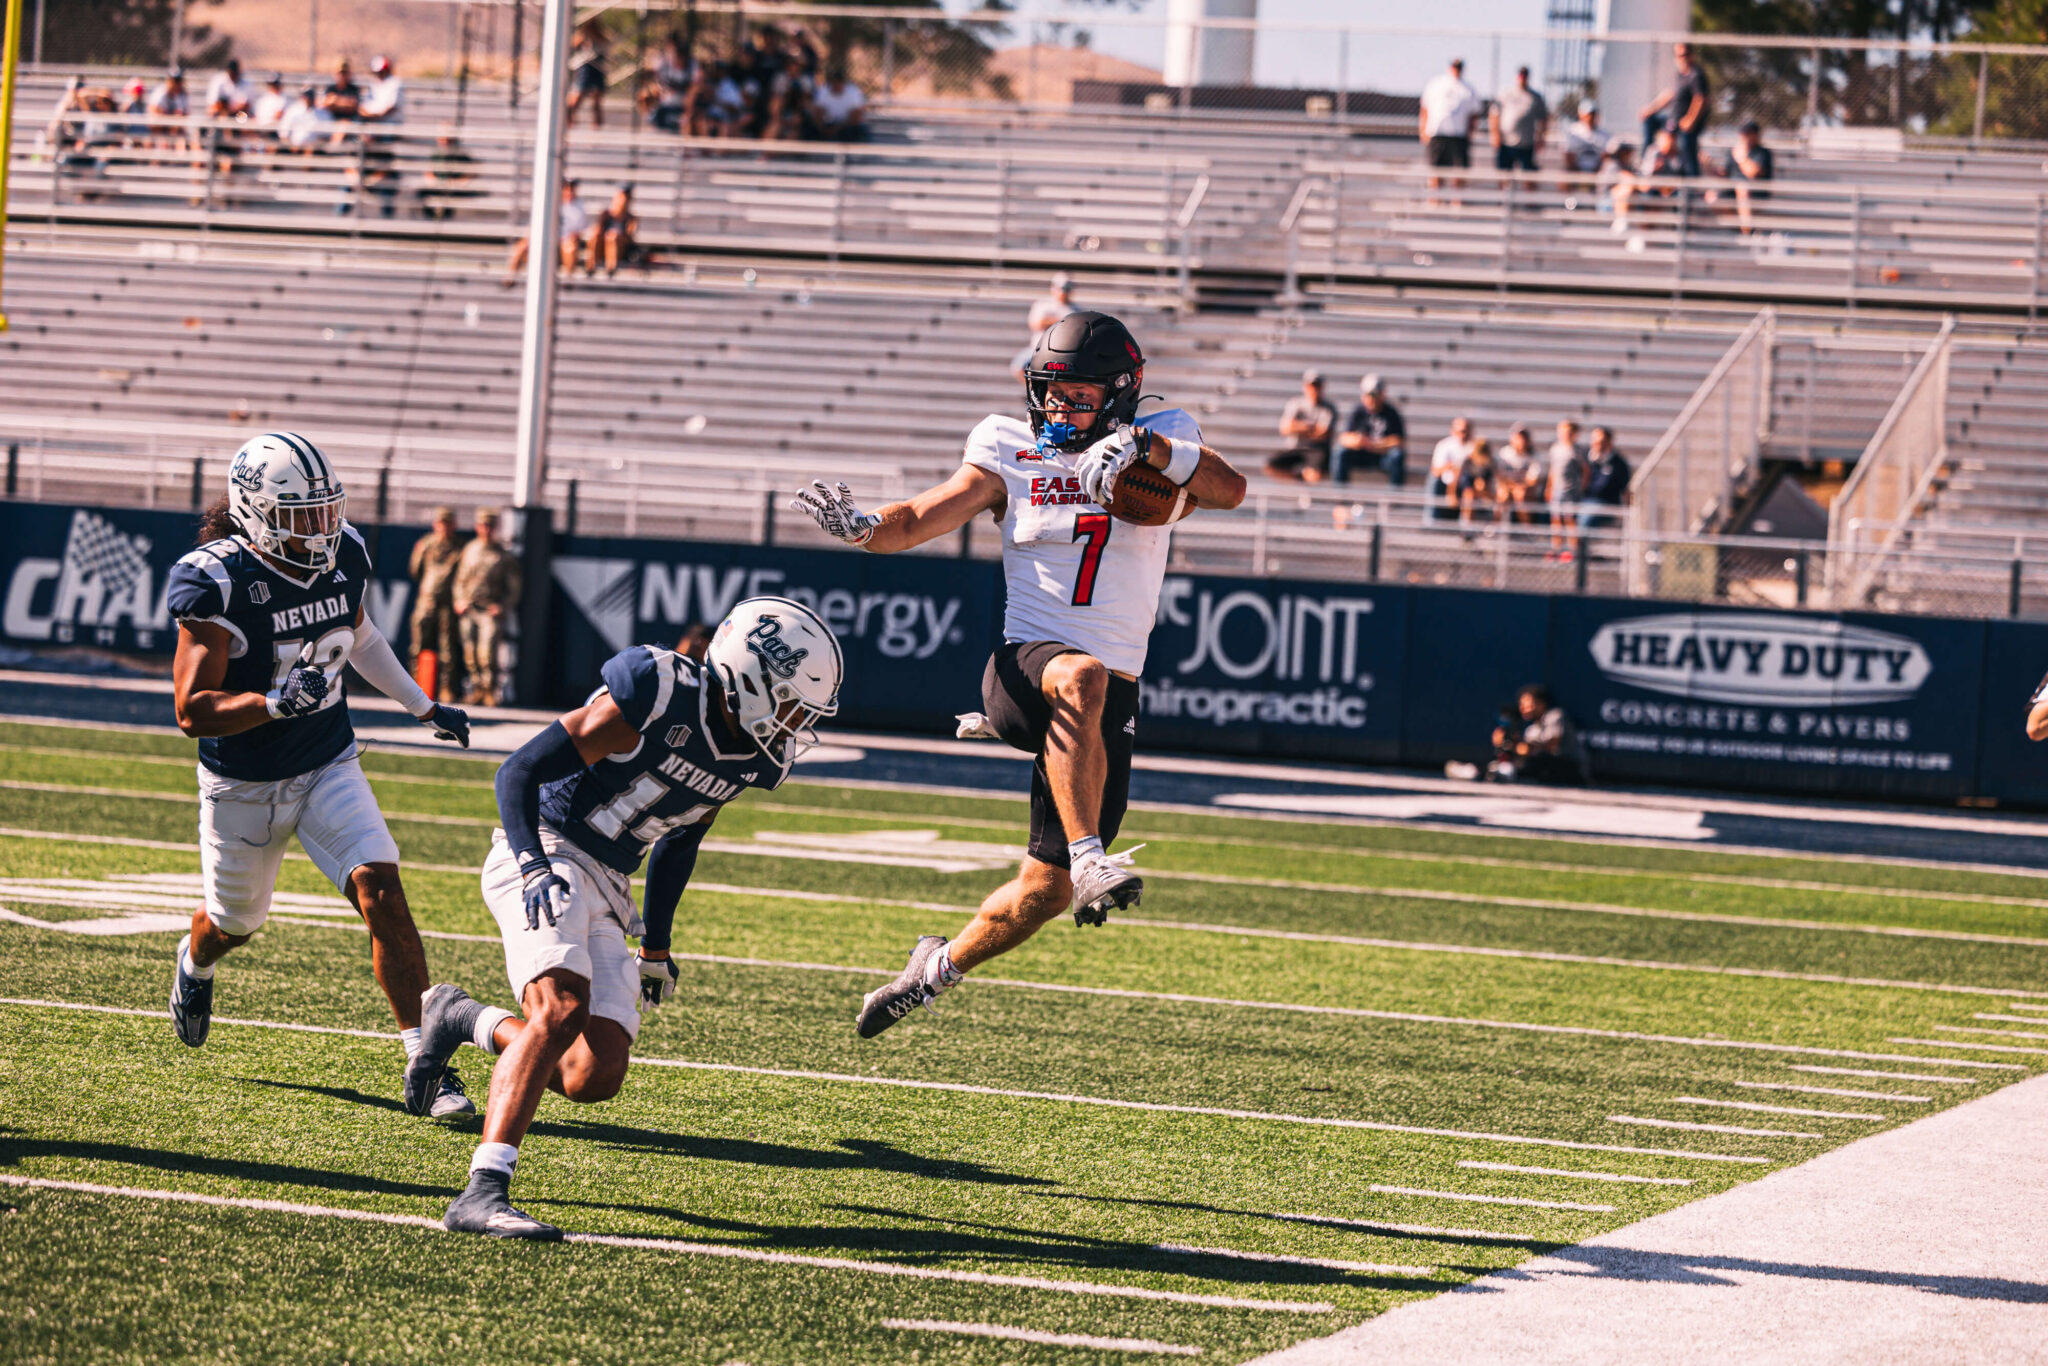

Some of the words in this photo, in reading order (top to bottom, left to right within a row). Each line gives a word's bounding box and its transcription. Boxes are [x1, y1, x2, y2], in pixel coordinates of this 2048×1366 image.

[229, 449, 268, 493] Pack
[1031, 476, 1081, 494] EAS
[1030, 493, 1092, 506] WASHI
[1071, 513, 1112, 606] 7
[271, 593, 350, 634] NEVADA
[1177, 591, 1374, 684] JOINT
[745, 613, 809, 679] Pack
[1612, 633, 1770, 675] HEAVY
[1781, 643, 1912, 683] DUTY
[1138, 678, 1367, 728] hiropractic
[1601, 699, 1760, 742] CONCRETE
[1768, 711, 1788, 735] &
[1799, 713, 1910, 742] PAVERS
[657, 752, 741, 801] NEVADA
